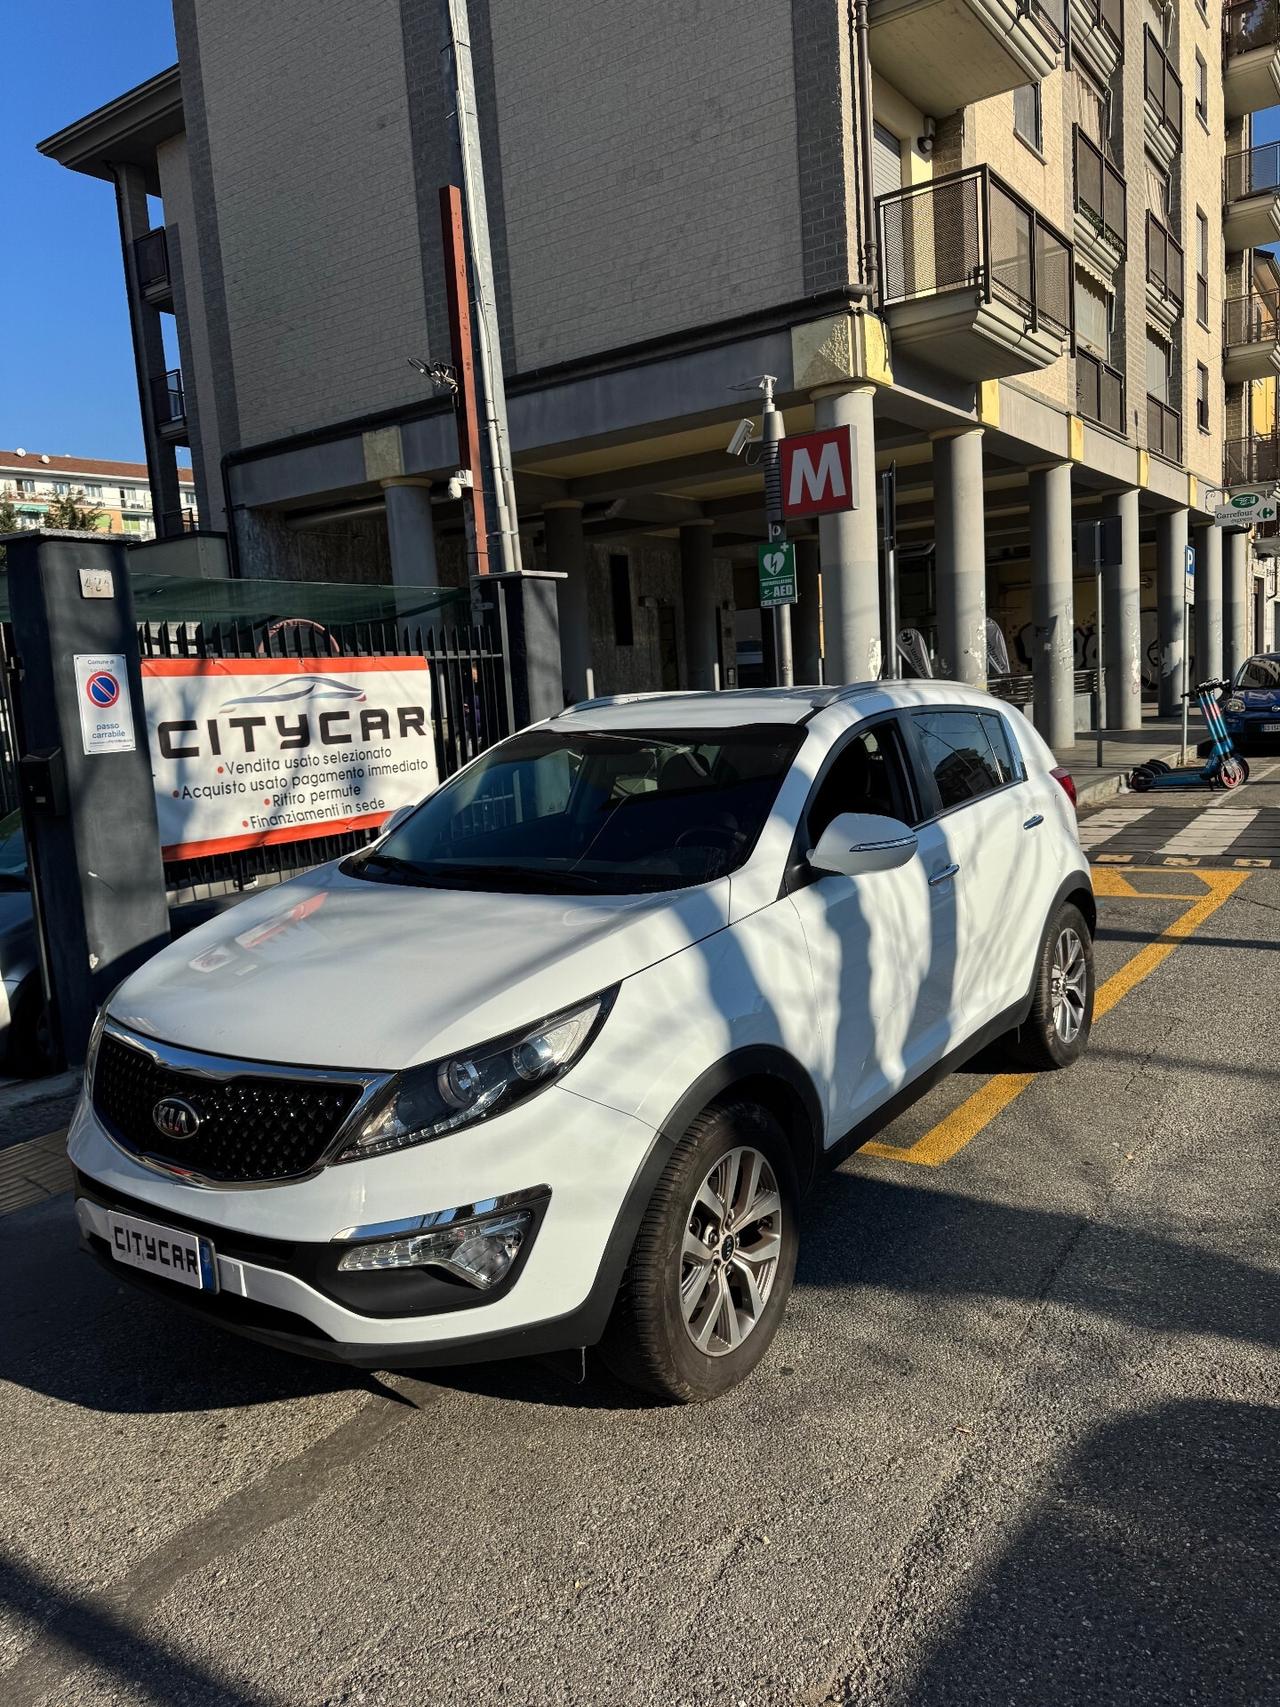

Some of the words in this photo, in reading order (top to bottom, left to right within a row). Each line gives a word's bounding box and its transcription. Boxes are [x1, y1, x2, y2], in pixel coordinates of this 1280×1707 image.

[788, 441, 847, 506] M
[1216, 510, 1253, 519] Carrefour
[1187, 549, 1194, 571] P
[773, 585, 793, 597] AED
[92, 730, 125, 739] carrabile
[97, 723, 120, 731] passo
[157, 706, 427, 760] CITYCAR
[225, 758, 280, 775] Vendita
[285, 754, 320, 769] usato
[323, 747, 392, 765] selezionato
[182, 780, 246, 800] Acquisto
[250, 776, 288, 791] usato
[292, 766, 365, 789] pagamento
[368, 758, 428, 777] immediato
[273, 793, 305, 807] Ritiro
[310, 784, 361, 804] permute
[250, 804, 339, 828] Finanziamenti
[342, 801, 353, 815] in
[356, 797, 385, 812] sede
[157, 1104, 189, 1134] KIA
[113, 1225, 199, 1275] CITYCAR
